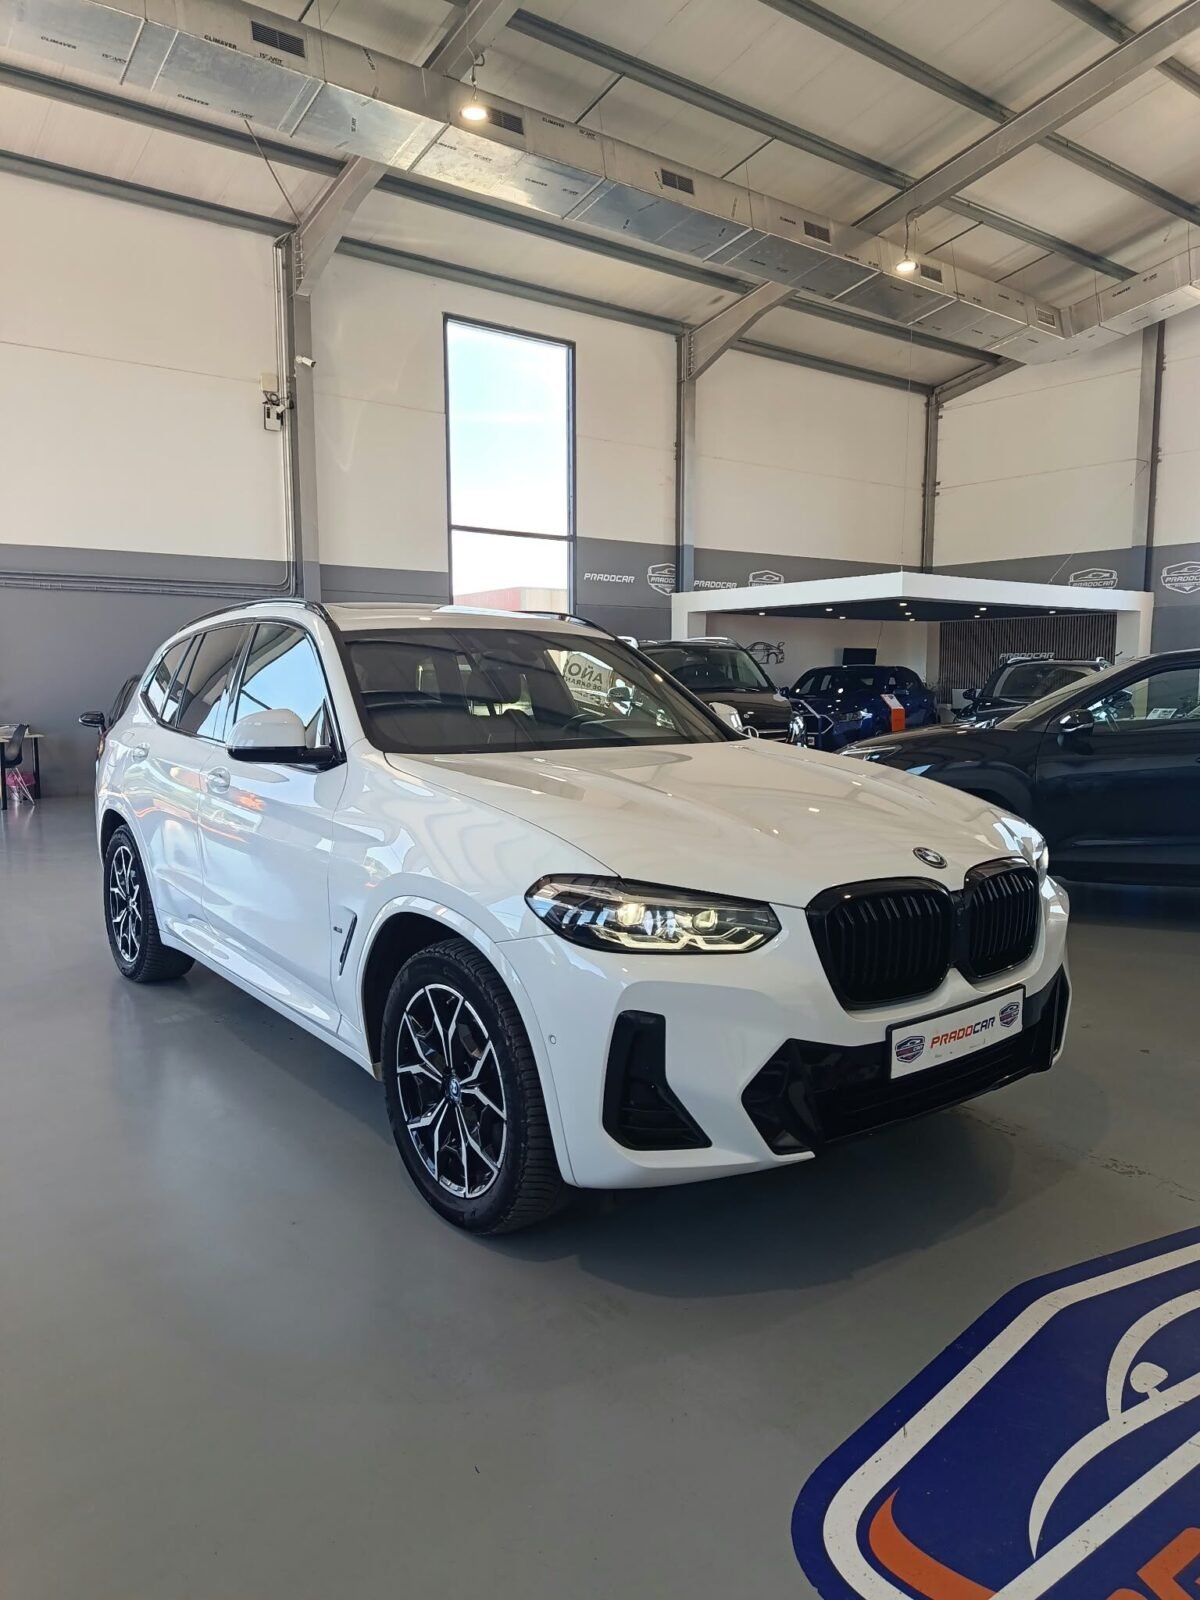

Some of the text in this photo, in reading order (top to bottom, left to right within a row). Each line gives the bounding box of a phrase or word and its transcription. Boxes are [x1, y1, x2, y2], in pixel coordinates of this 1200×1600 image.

[40, 36, 77, 49] CLIMAVER
[204, 34, 237, 50] CLIMAVER
[584, 573, 635, 583] PRADOCAR
[694, 580, 737, 589] PRADOCAR
[930, 1016, 995, 1048] PRADOCAR
